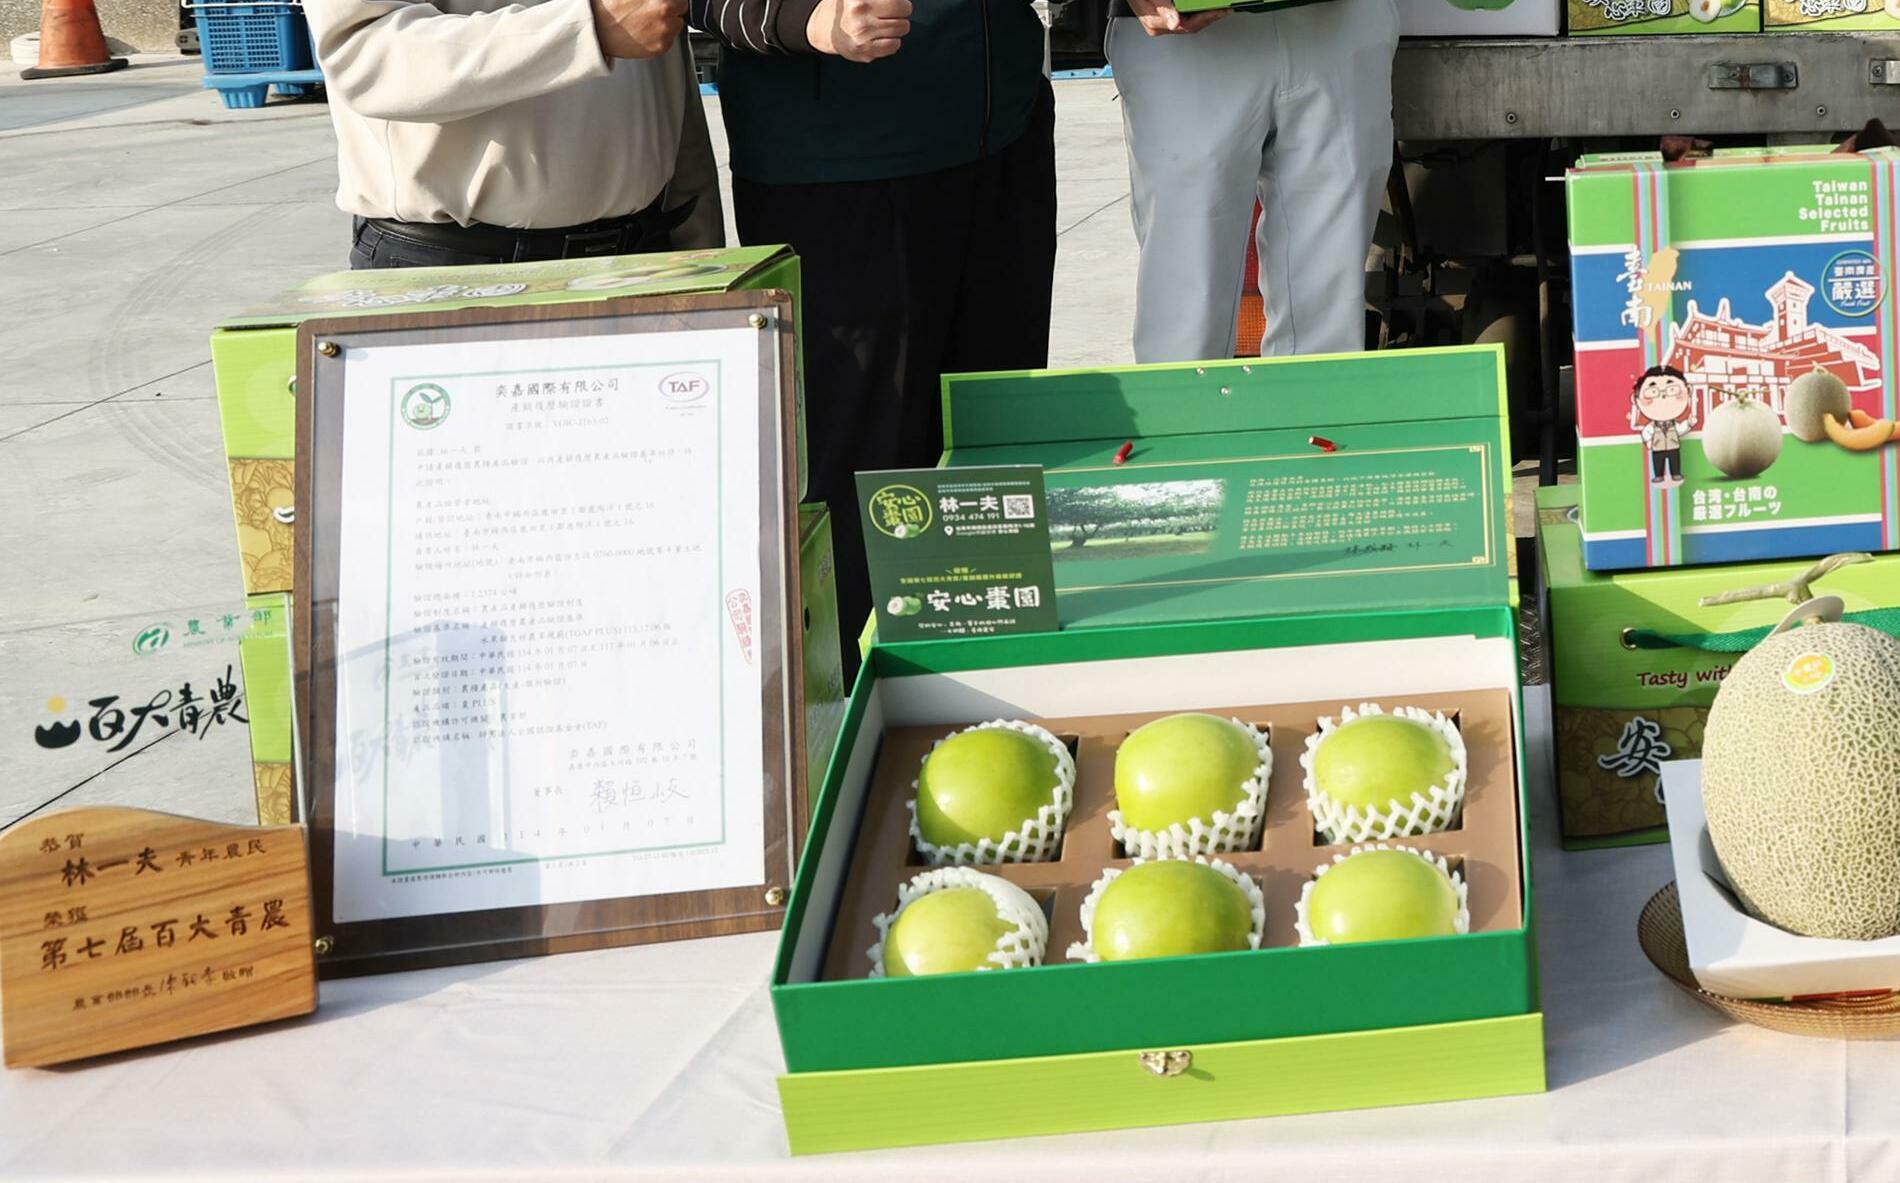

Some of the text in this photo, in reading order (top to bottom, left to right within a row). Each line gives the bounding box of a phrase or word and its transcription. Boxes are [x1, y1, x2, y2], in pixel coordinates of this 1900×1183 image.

[1812, 181, 1868, 193] Taiwan
[1815, 193, 1868, 206] Tainan
[1799, 207, 1868, 220] Selected
[1820, 219, 1869, 233] Fruits
[1616, 244, 1652, 328] 臺南
[1648, 281, 1692, 292] TAINAN
[668, 381, 701, 396] TAF
[939, 495, 999, 513] 林一夫
[943, 514, 966, 522] 0934
[969, 513, 985, 521] 474
[927, 585, 1041, 613] 安心棗園
[1636, 669, 1689, 688] Tasty
[88, 665, 250, 753] 百大青農
[62, 839, 267, 888] 林一夫 青年農民
[40, 899, 290, 970] 第七屆百大青農
